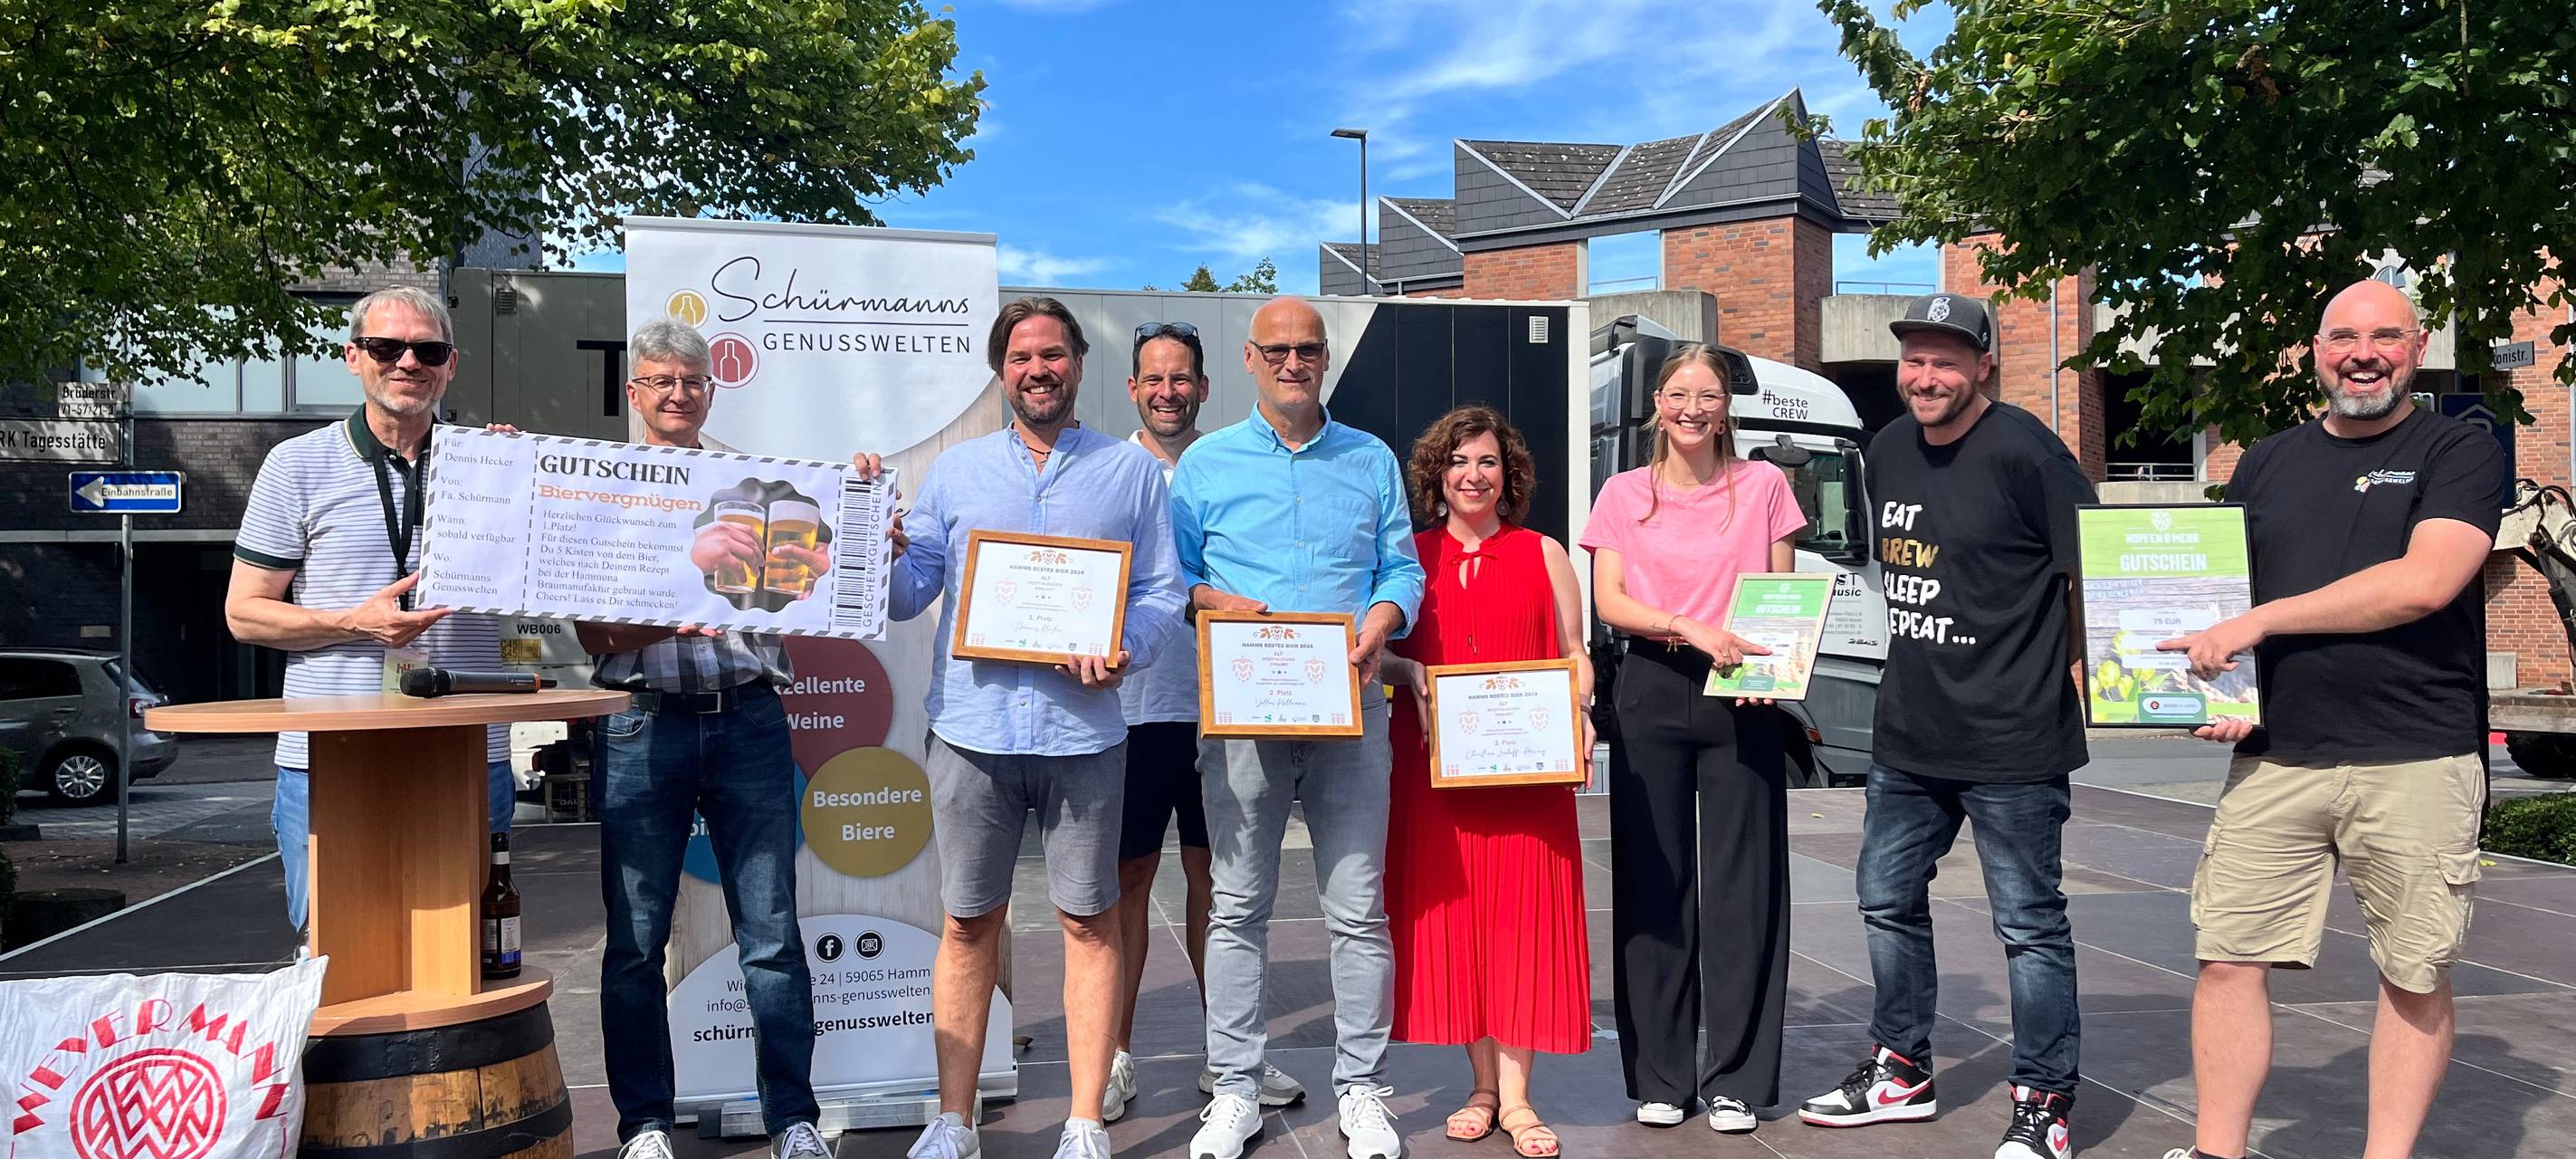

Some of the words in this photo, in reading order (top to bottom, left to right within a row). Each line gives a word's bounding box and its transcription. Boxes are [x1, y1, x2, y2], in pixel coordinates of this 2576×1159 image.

[711, 255, 970, 322] Schürmanns
[763, 332, 970, 354] GENUSSWELTEN
[2495, 349, 2528, 365] onistr.
[62, 386, 118, 399] Brüderstr.
[1761, 388, 1808, 408] #beste
[1772, 407, 1808, 420] CREW
[22, 430, 106, 452] Tagesstätte
[444, 437, 463, 447] Für:
[444, 452, 478, 464] Dennis
[480, 455, 514, 466] Hecker
[539, 455, 690, 486] GUTSCHEIN
[441, 476, 463, 486] Von:
[101, 486, 173, 497] Einbahnstraße
[458, 492, 510, 504] Schürmann
[538, 484, 702, 512] Biervergnügen
[437, 514, 467, 524] Wann:
[543, 510, 593, 522] Herzlichen
[595, 514, 655, 527] Glückwunsch
[657, 521, 677, 529] zum
[1881, 501, 1923, 532] EAT
[436, 530, 468, 540] sobald
[471, 532, 516, 543] verfügbar
[541, 532, 558, 542] Für
[559, 534, 588, 545] diesen
[590, 537, 635, 549] Gutschein
[637, 541, 684, 552] bekommst
[2125, 532, 2162, 544] HOPFEN
[2172, 532, 2200, 543] MEHR
[539, 544, 554, 554] Du
[557, 545, 562, 554] 5
[565, 546, 595, 557] Kisten
[596, 551, 614, 559] von
[615, 551, 635, 560] dem
[637, 552, 660, 563] Bier,
[863, 482, 883, 627] GESCHENKGUTSCHEIN
[1882, 537, 1940, 569] BREW
[2120, 553, 2208, 571] GUTSCHEIN
[538, 568, 552, 577] bei
[554, 569, 570, 579] der
[571, 570, 618, 582] Hammona
[539, 557, 576, 568] welches
[577, 559, 599, 570] nach
[601, 560, 637, 572] Deinem
[639, 563, 670, 576] Rezept
[434, 570, 491, 582] Schürmanns
[1837, 572, 1858, 586] ST
[432, 581, 498, 595] Genusswelten
[537, 580, 610, 593] Braumanufaktur
[612, 584, 646, 597] gebraut
[1884, 570, 1942, 607] SLEEP
[536, 591, 571, 602] Cheers!
[574, 593, 595, 604] Lass
[608, 596, 625, 606] Dir
[625, 598, 679, 609] schmecken!
[516, 624, 561, 635] WB006
[1889, 607, 1977, 645] EPEAT...
[773, 675, 865, 695] zellente
[813, 786, 922, 808] Besondere
[841, 823, 895, 841] Biere
[819, 972, 835, 985] 24
[845, 970, 884, 983] 59065
[888, 968, 930, 981] Hamm
[13, 998, 291, 1135] WEYERMANN
